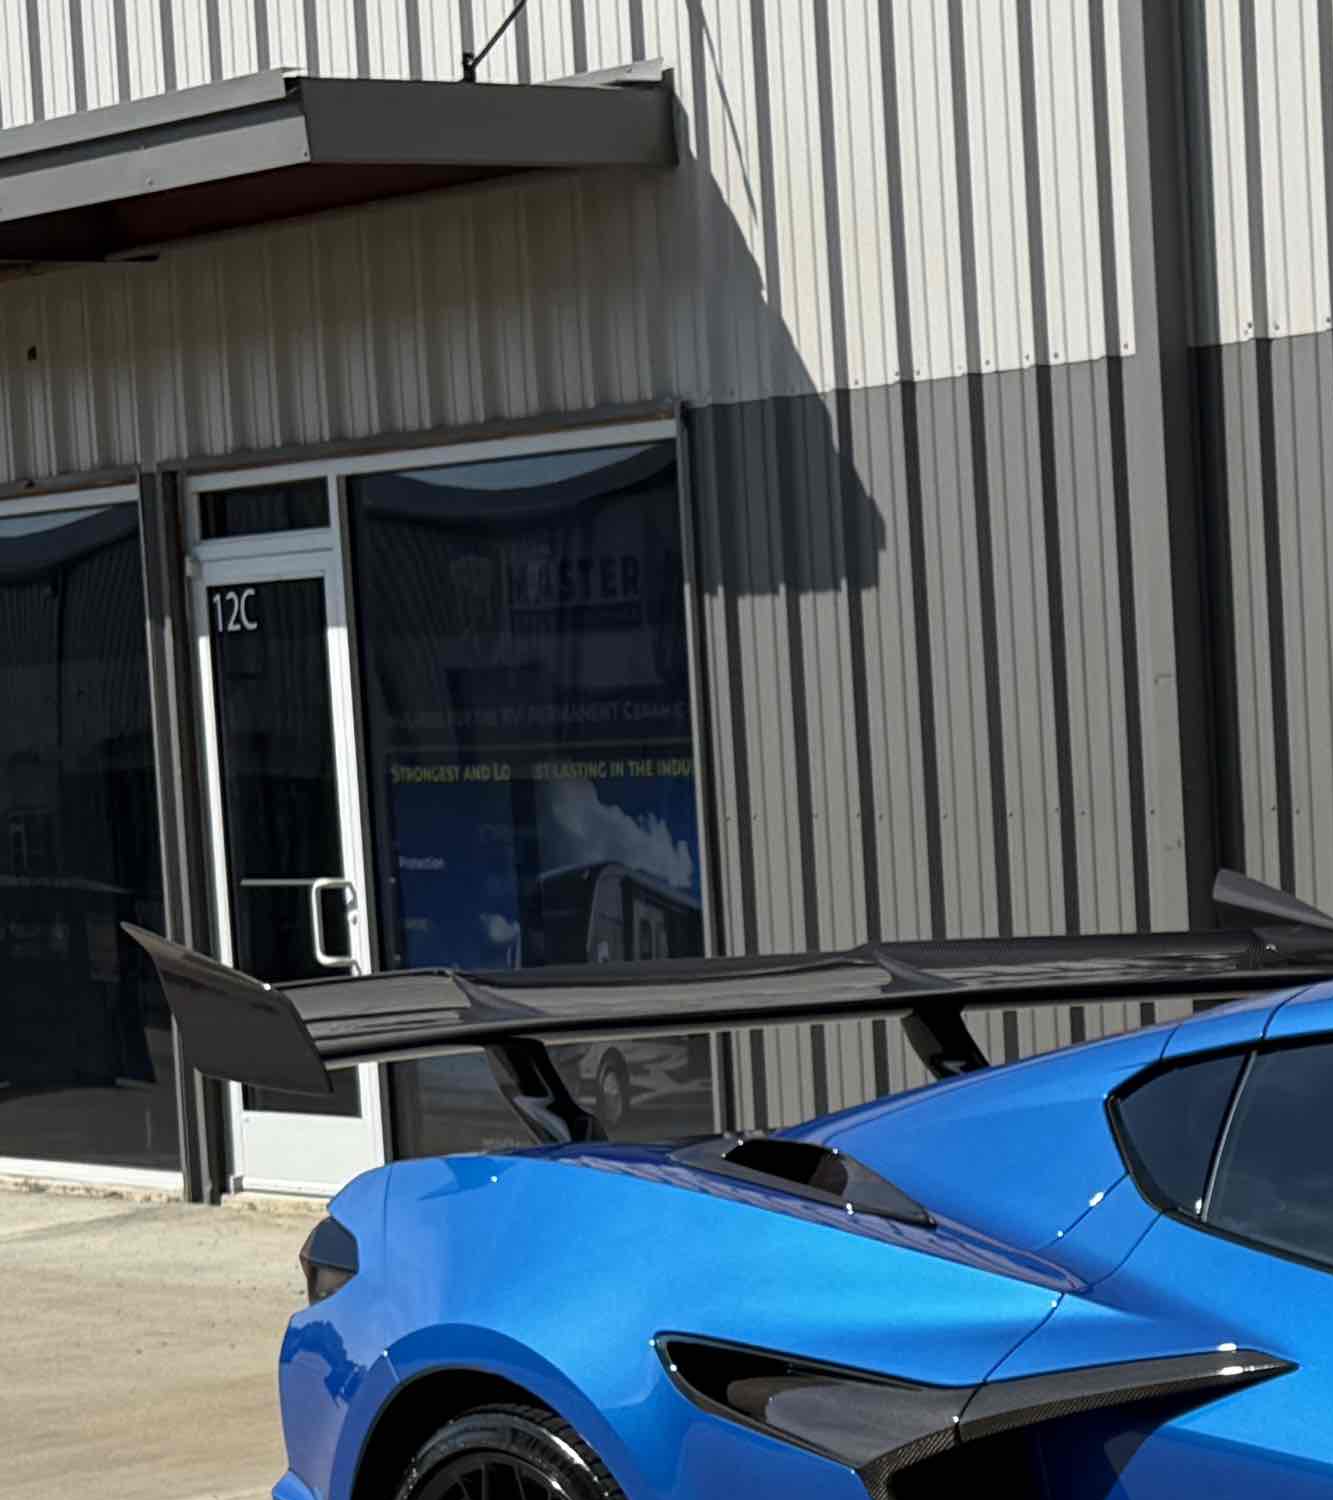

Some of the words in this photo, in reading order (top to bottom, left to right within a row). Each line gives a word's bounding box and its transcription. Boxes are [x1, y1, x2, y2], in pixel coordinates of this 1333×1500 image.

[213, 587, 258, 632] 12C
[391, 764, 459, 784] STRONGEST
[463, 763, 491, 782] AND
[610, 760, 625, 777] IN
[628, 760, 654, 777] THE
